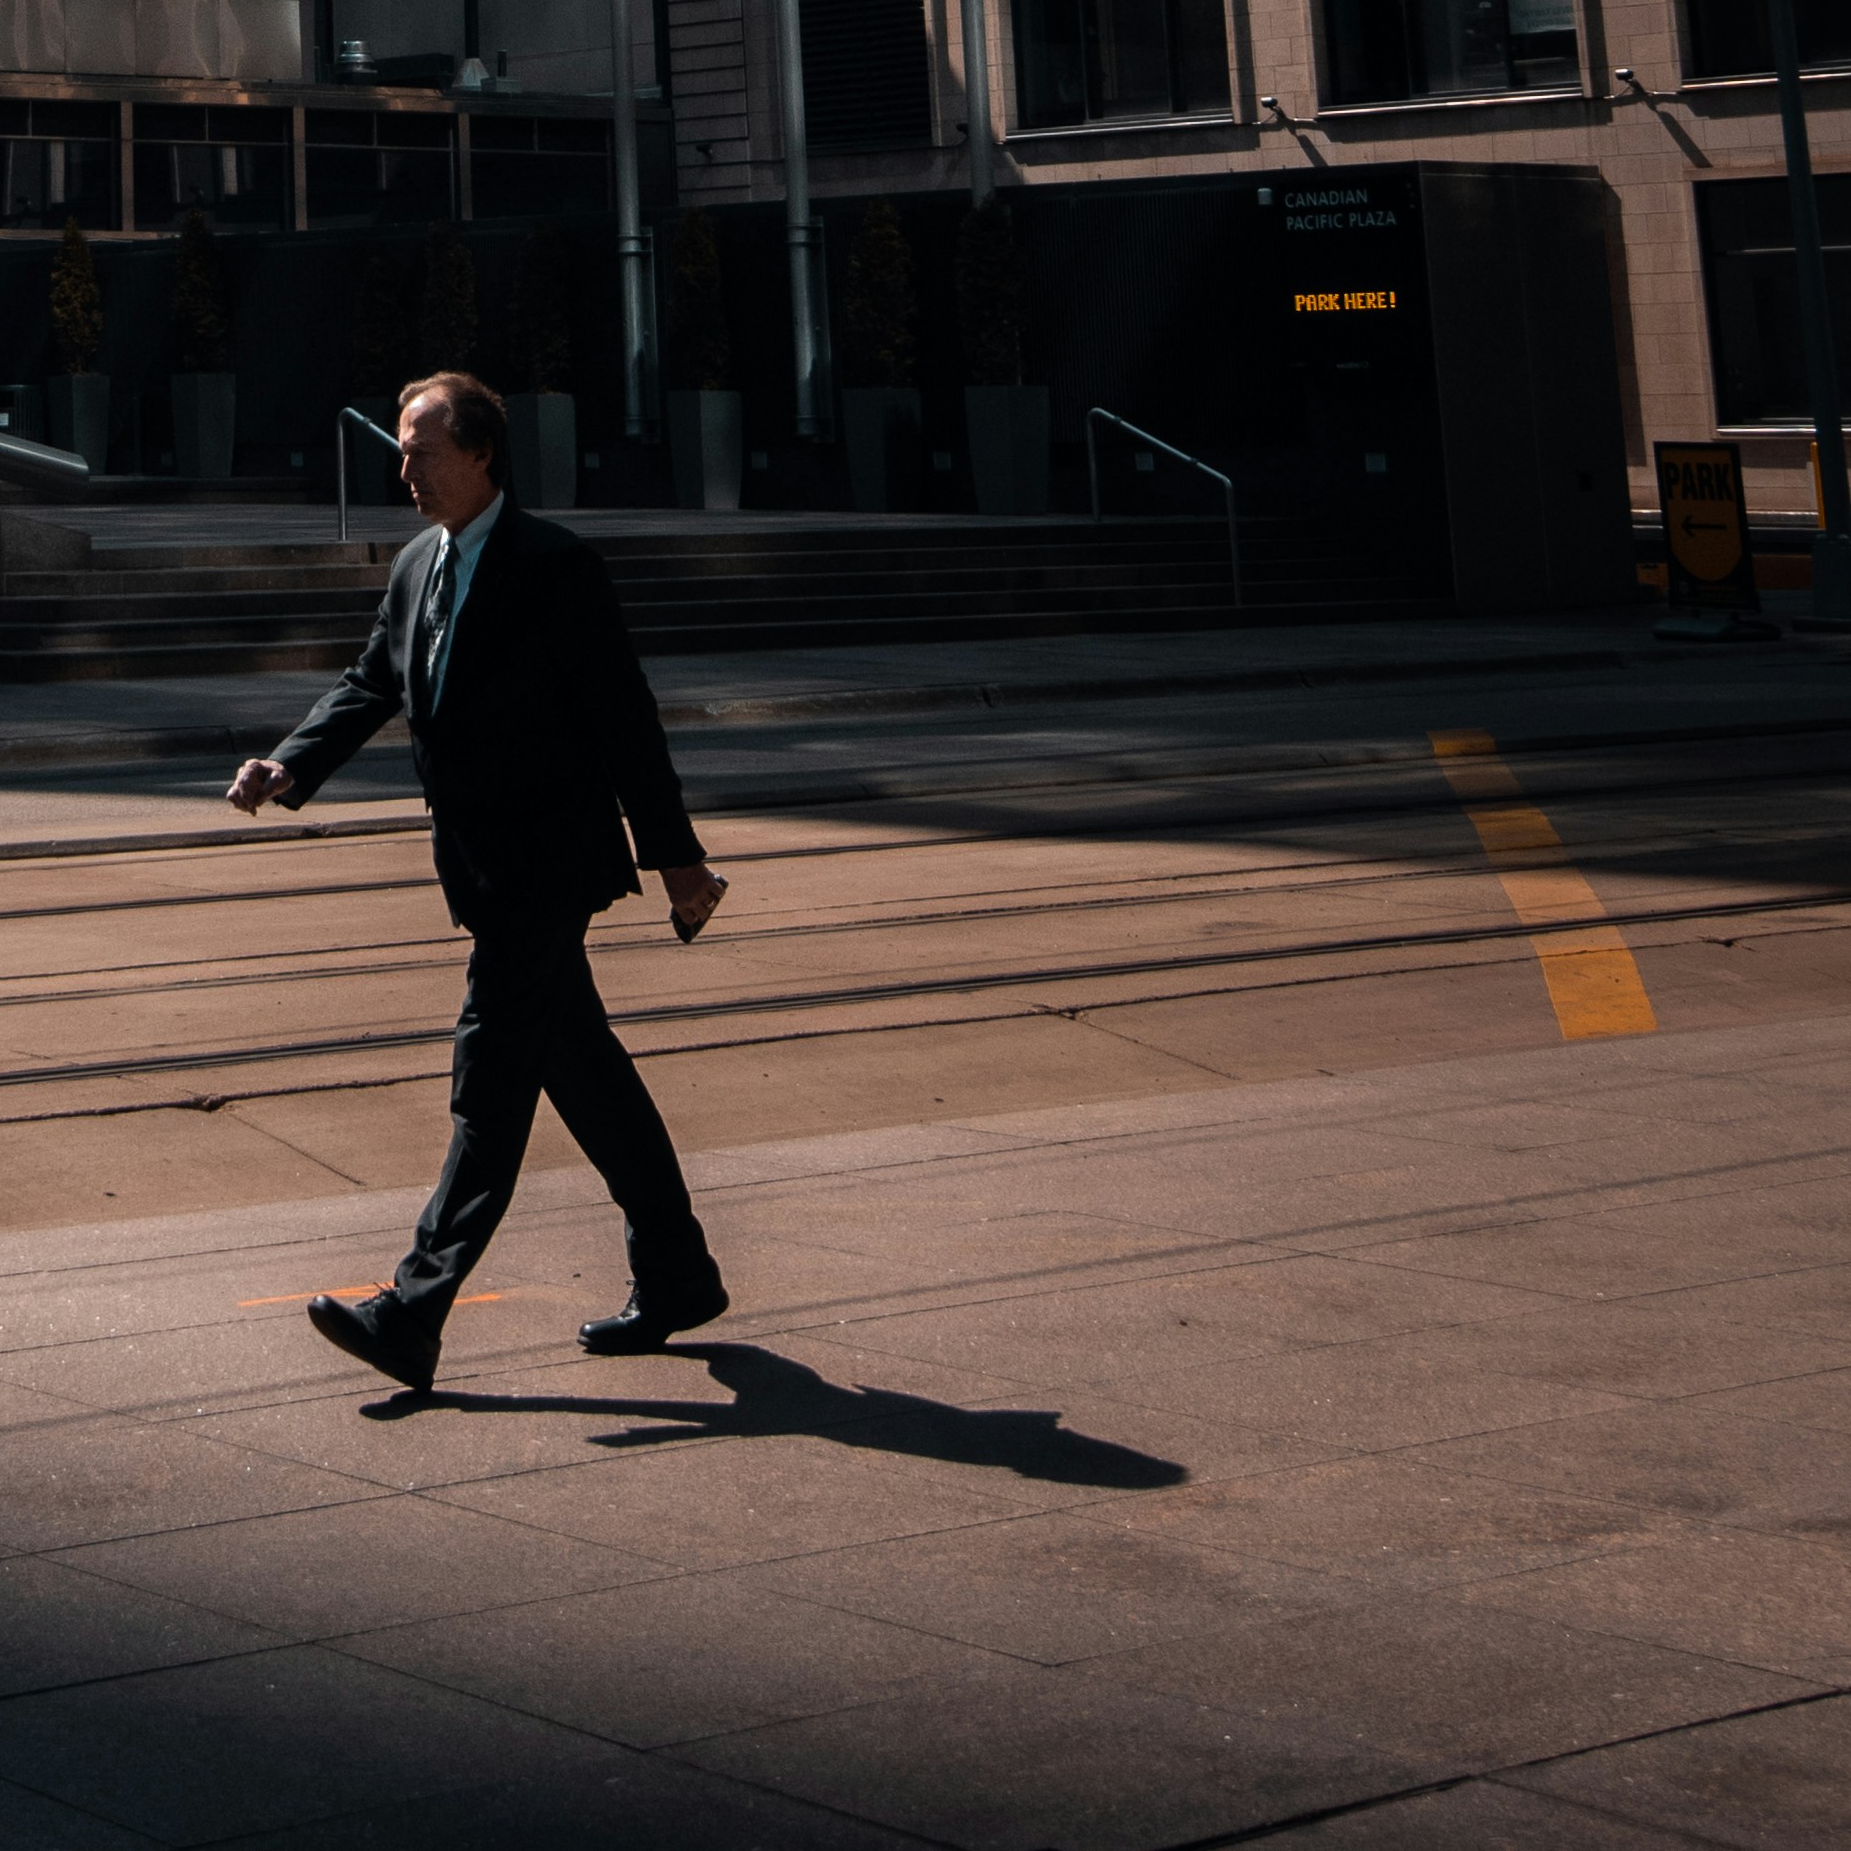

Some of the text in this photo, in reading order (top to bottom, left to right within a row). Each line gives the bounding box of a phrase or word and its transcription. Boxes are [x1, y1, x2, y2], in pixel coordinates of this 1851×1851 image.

[1284, 188, 1369, 209] CANADIAN
[1286, 210, 1398, 232] PACIFIC PLAZA
[1294, 291, 1398, 312] PARK HERE!
[1664, 461, 1735, 501] PARK
